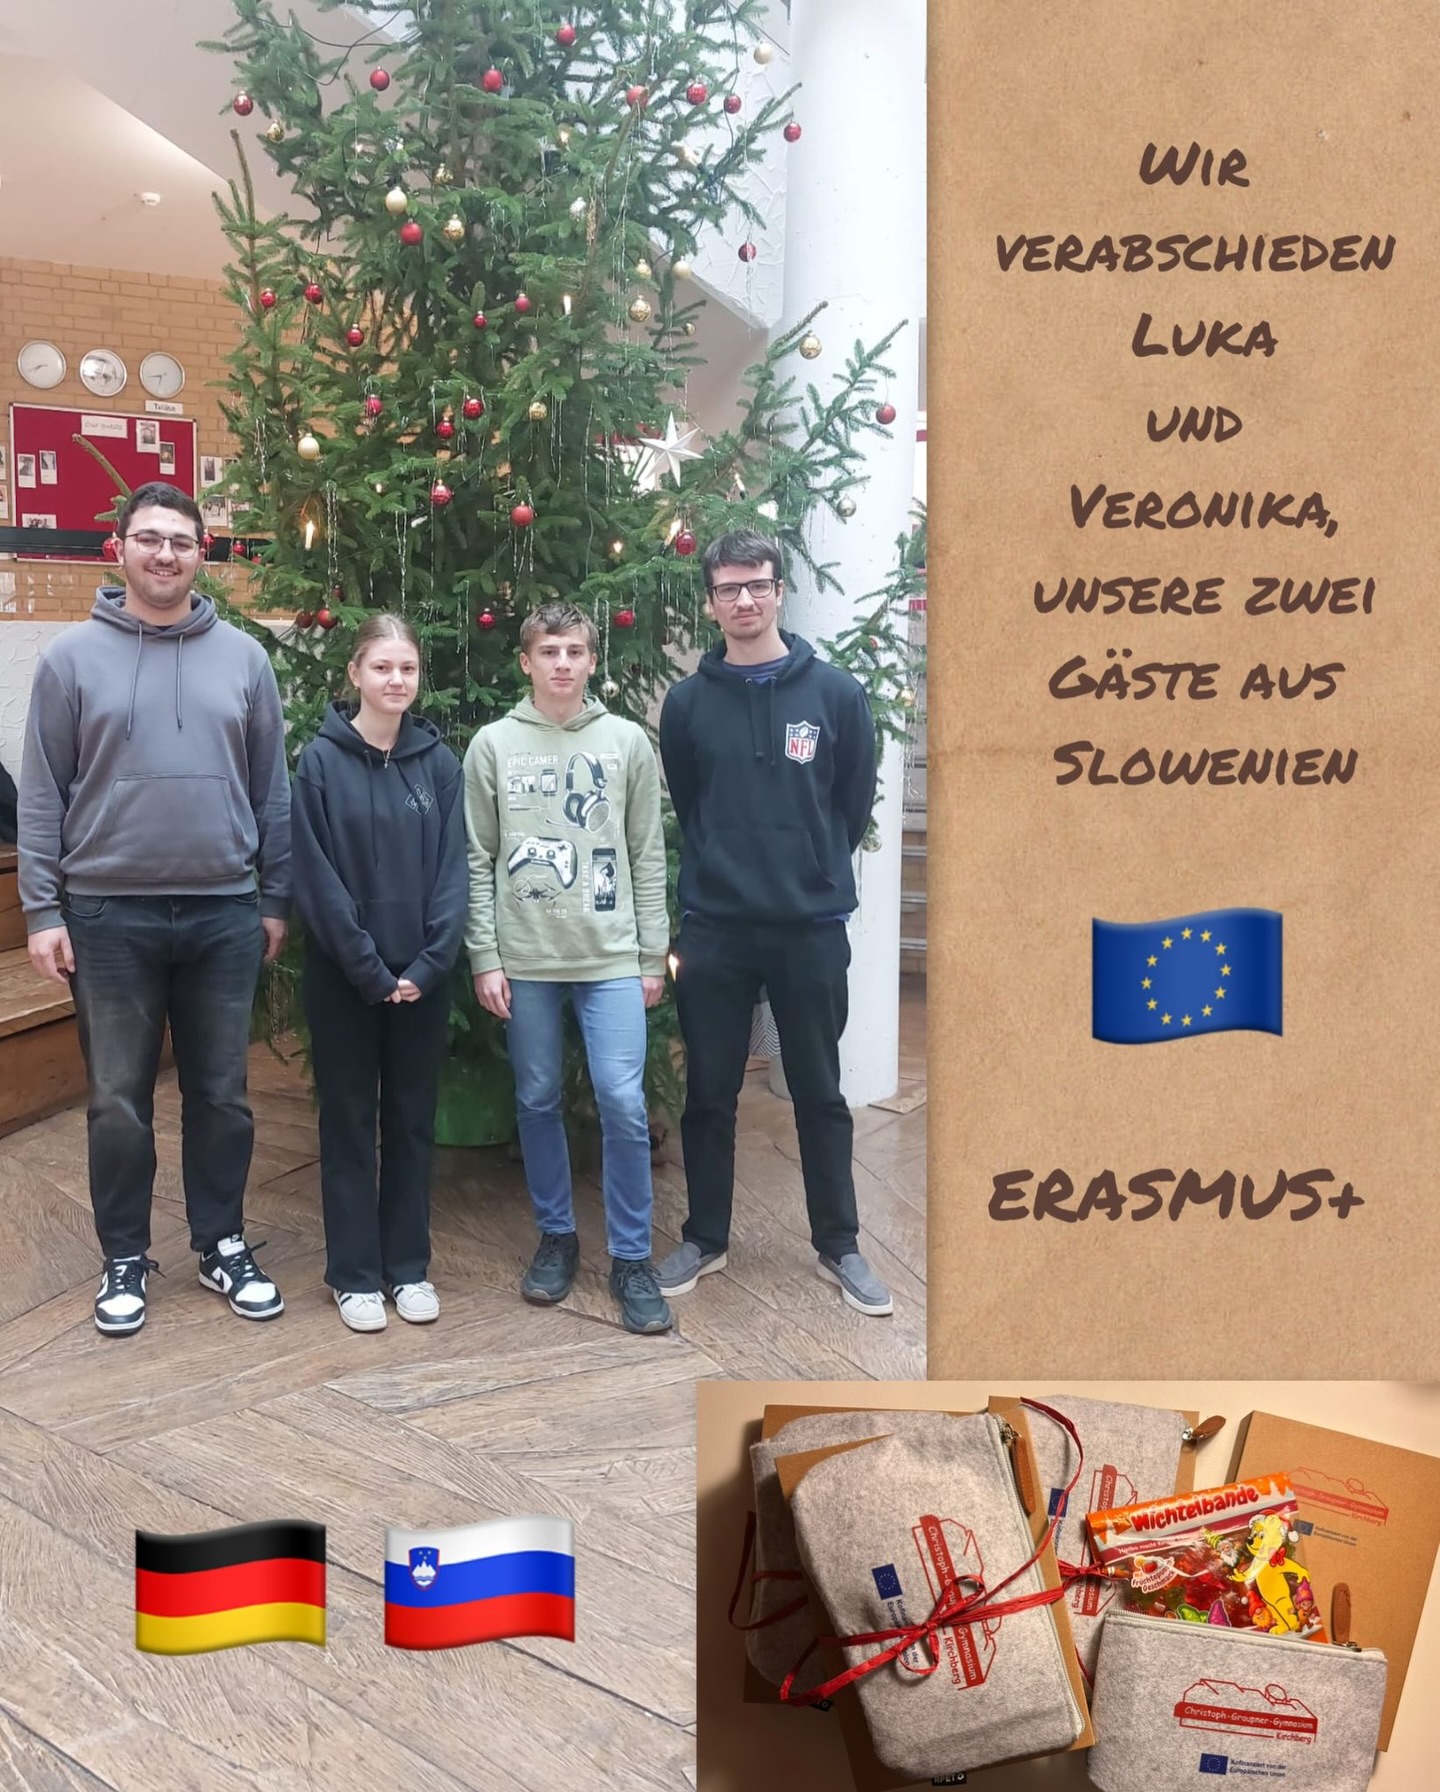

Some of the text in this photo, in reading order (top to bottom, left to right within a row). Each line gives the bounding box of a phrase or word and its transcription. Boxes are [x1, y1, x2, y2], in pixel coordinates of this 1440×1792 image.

[790, 738, 812, 757] NFL
[507, 754, 559, 768] EPIC GAMER
[1131, 1485, 1260, 1532] Wichtelbande
[944, 1637, 962, 1686] Kirchberg
[1184, 1705, 1313, 1730] Christoph-Graupner-Gymnasium
[1275, 1731, 1312, 1746] Kirchberg
